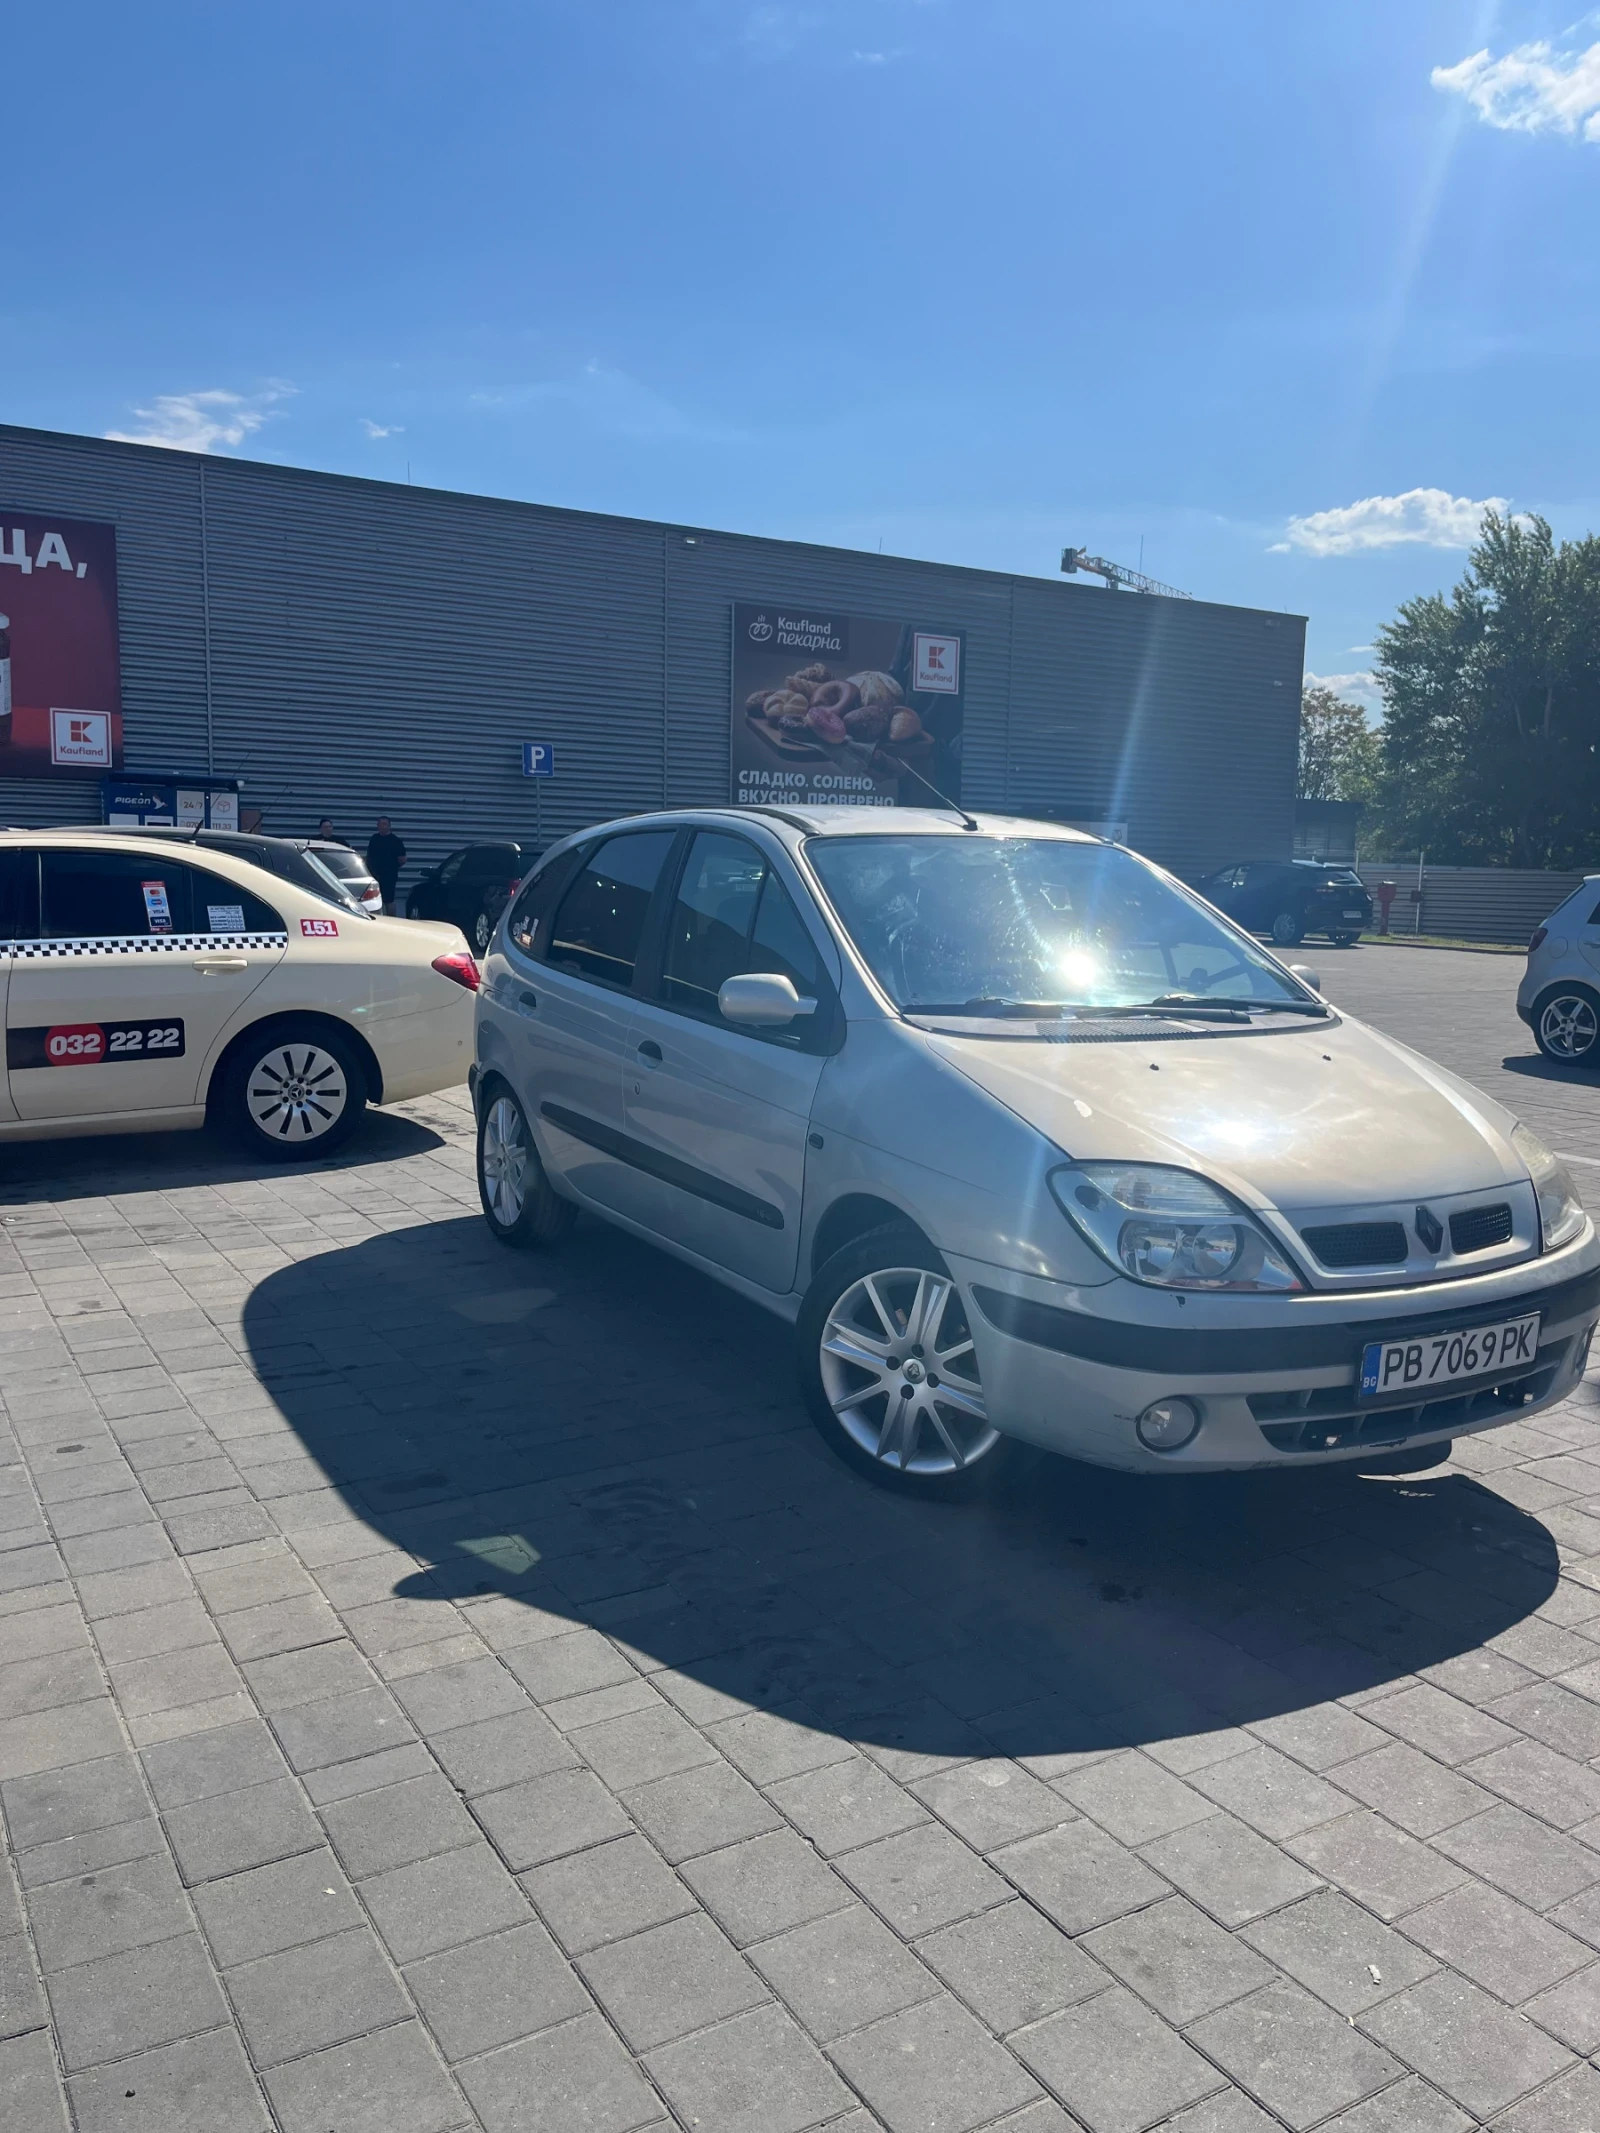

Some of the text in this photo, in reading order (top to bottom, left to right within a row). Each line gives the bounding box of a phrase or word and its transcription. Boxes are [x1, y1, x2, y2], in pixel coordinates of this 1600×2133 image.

[777, 616, 832, 635] Kaufland
[776, 630, 841, 651] пекарна
[920, 671, 953, 684] Kaufland
[60, 744, 104, 757] Kaufland
[531, 746, 545, 769] P
[738, 769, 876, 791] СЛАДКО. СОЛЕНО.
[302, 919, 337, 937] 151
[49, 1027, 179, 1056] 032 22 22
[1382, 1321, 1533, 1387] PB 7069 PK
[1363, 1374, 1377, 1388] BG
